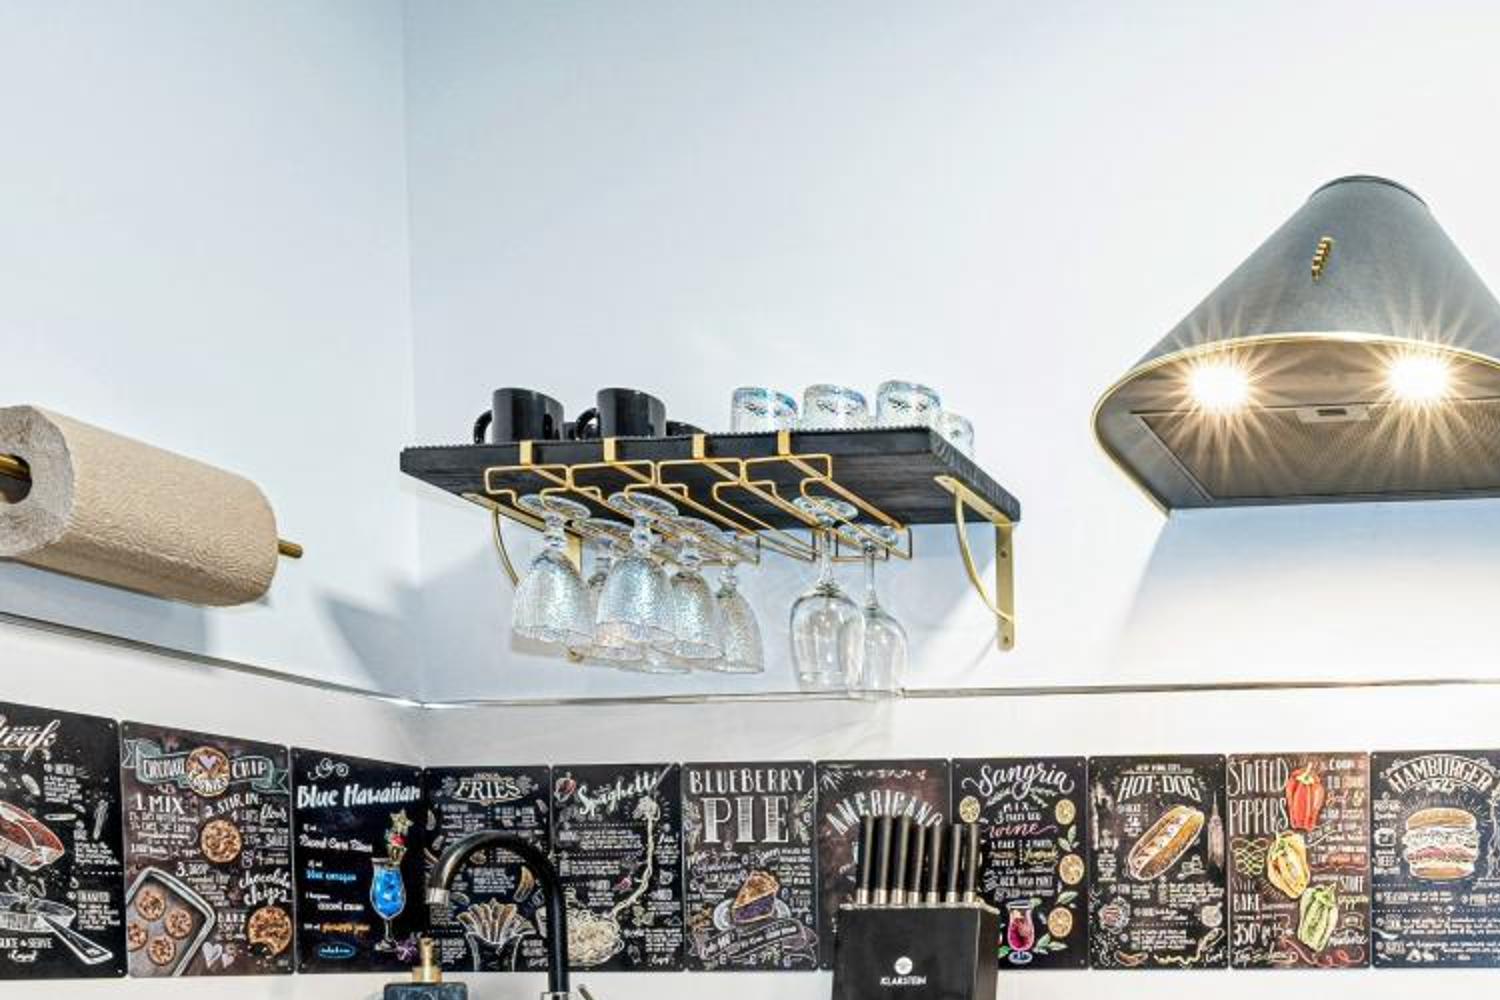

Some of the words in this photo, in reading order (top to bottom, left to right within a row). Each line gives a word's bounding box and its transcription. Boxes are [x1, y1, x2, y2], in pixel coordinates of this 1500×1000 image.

[231, 763, 267, 779] CHIP
[689, 768, 805, 794] BLUEBERRY
[961, 762, 1075, 801] Sangria
[1226, 757, 1289, 798] STUFFED
[1388, 756, 1493, 794] HAMBURGER
[297, 784, 339, 809] Blue
[343, 781, 420, 808] Hawaiian
[456, 780, 521, 801] FRIES
[1117, 775, 1154, 802] HOT
[1162, 775, 1203, 802] DOG
[700, 795, 789, 843] PIE
[1229, 797, 1289, 837] PEPPERS
